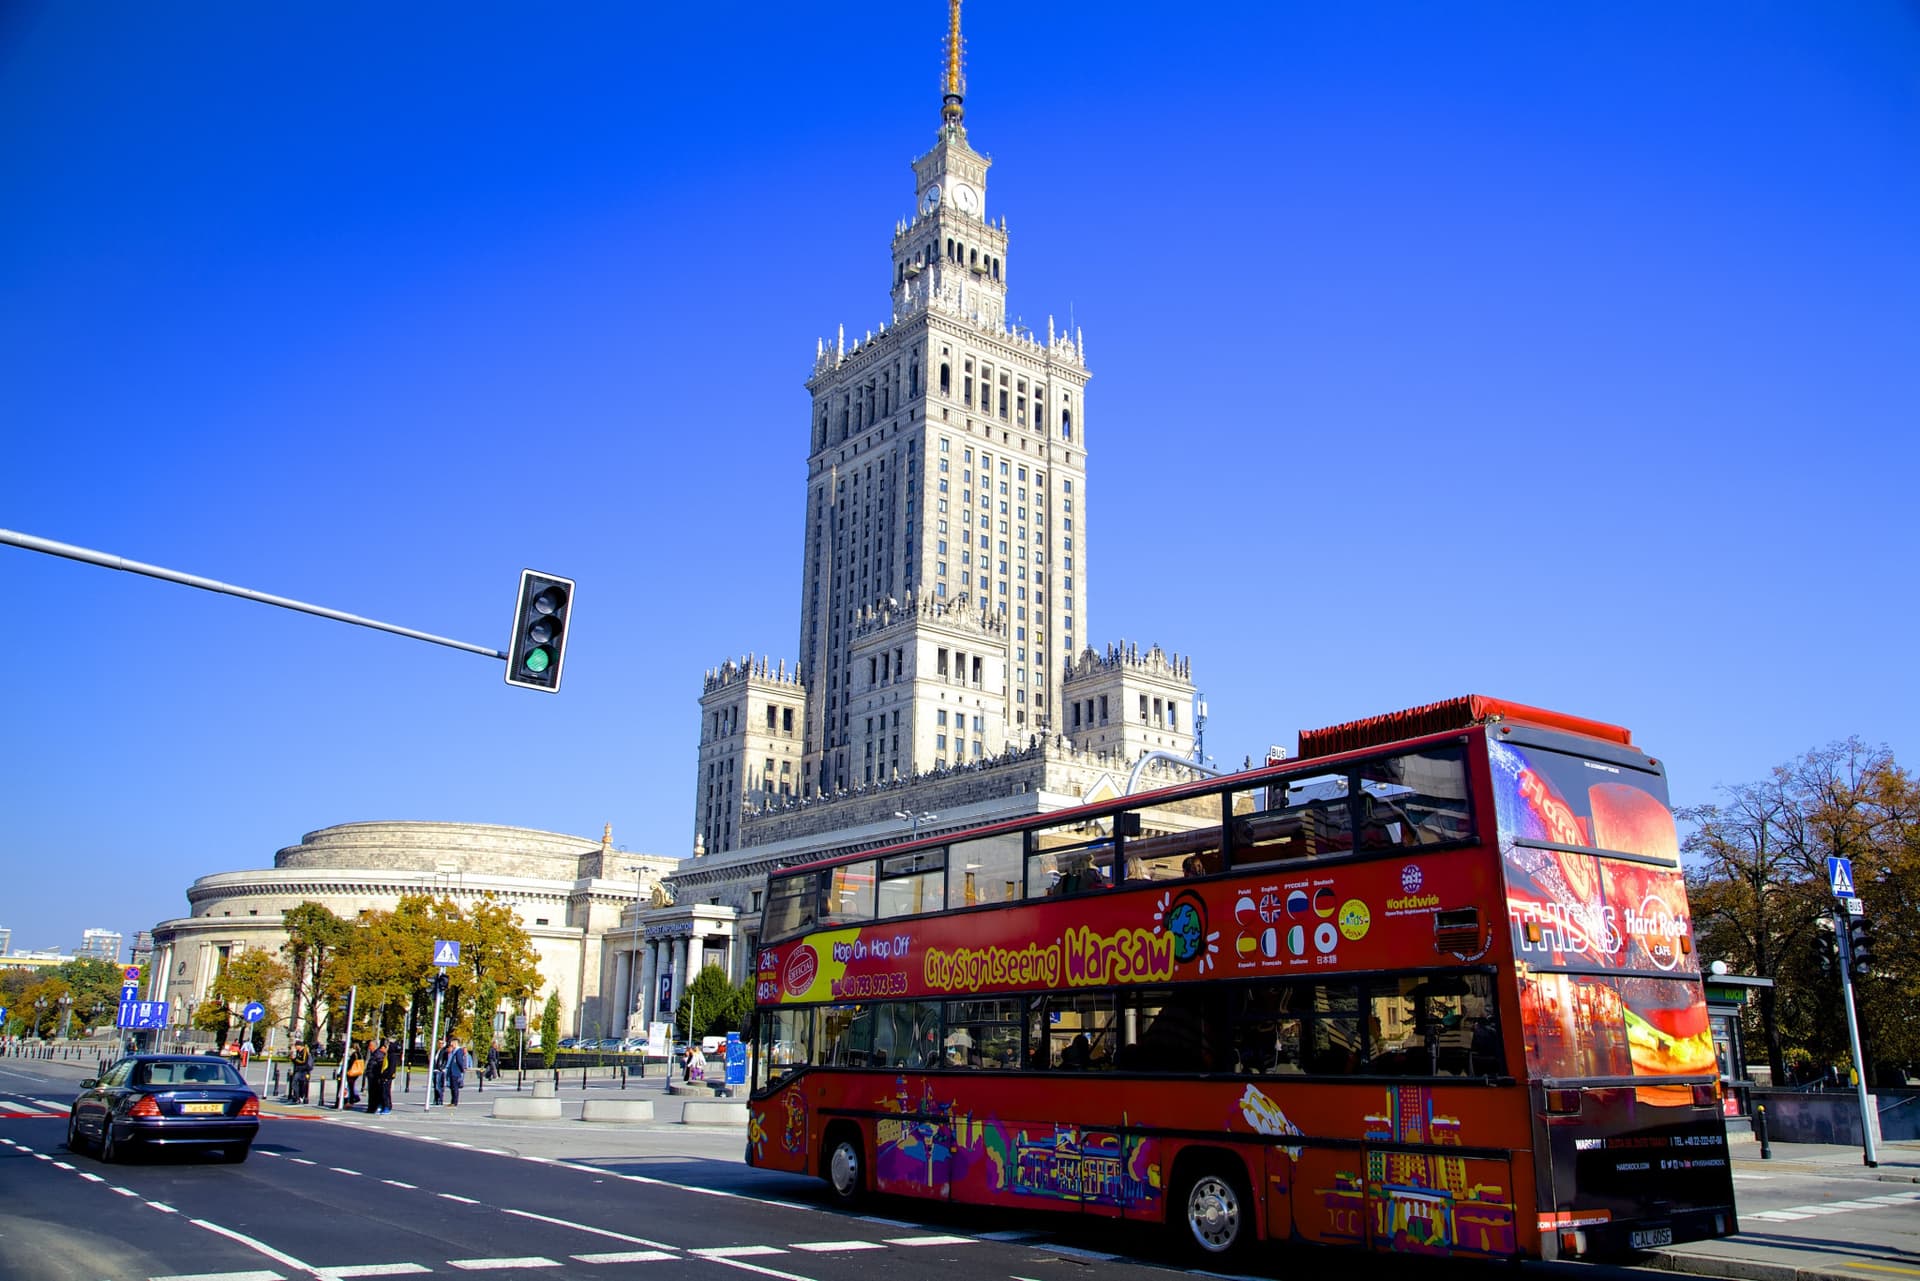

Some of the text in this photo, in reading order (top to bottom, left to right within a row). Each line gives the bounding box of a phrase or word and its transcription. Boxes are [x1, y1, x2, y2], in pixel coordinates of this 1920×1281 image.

[1271, 747, 1285, 759] BUS
[1261, 885, 1278, 893] English
[1849, 901, 1862, 912] BUS
[1508, 901, 1589, 952] THIS
[1624, 908, 1688, 942] Hard Rock
[832, 936, 910, 963] Hop On Hop Off
[923, 925, 1176, 993] CitySightseeing Warsaw
[1654, 944, 1672, 956] CAFE
[662, 977, 670, 1001] P
[1634, 1231, 1653, 1247] CAL
